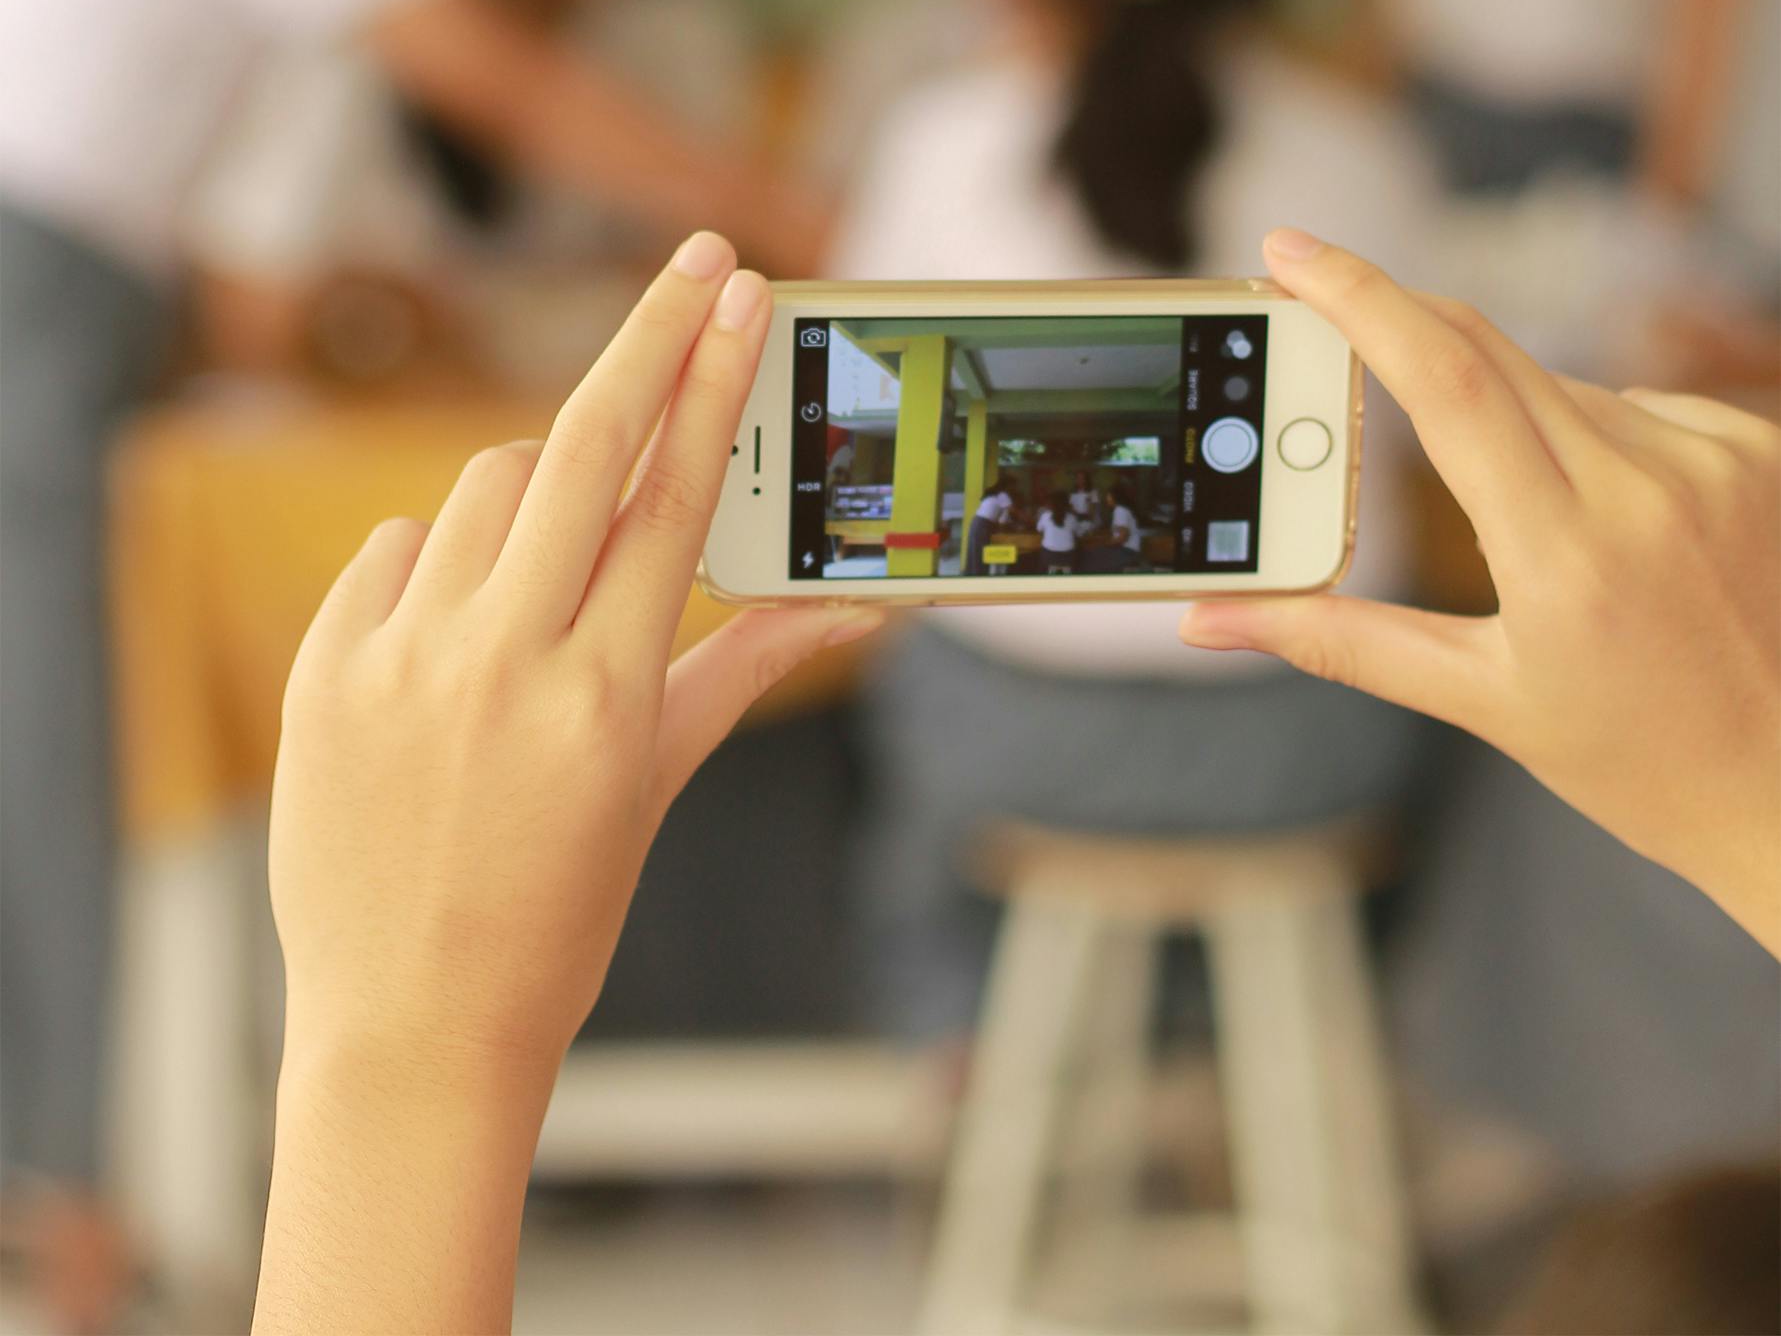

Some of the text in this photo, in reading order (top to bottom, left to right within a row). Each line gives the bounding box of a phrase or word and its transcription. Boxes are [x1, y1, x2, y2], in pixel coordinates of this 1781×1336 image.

[1187, 369, 1198, 411] SQUARE
[1185, 428, 1196, 464] PHOTO
[797, 482, 821, 492] HDR
[1183, 481, 1194, 512] VIDEO
